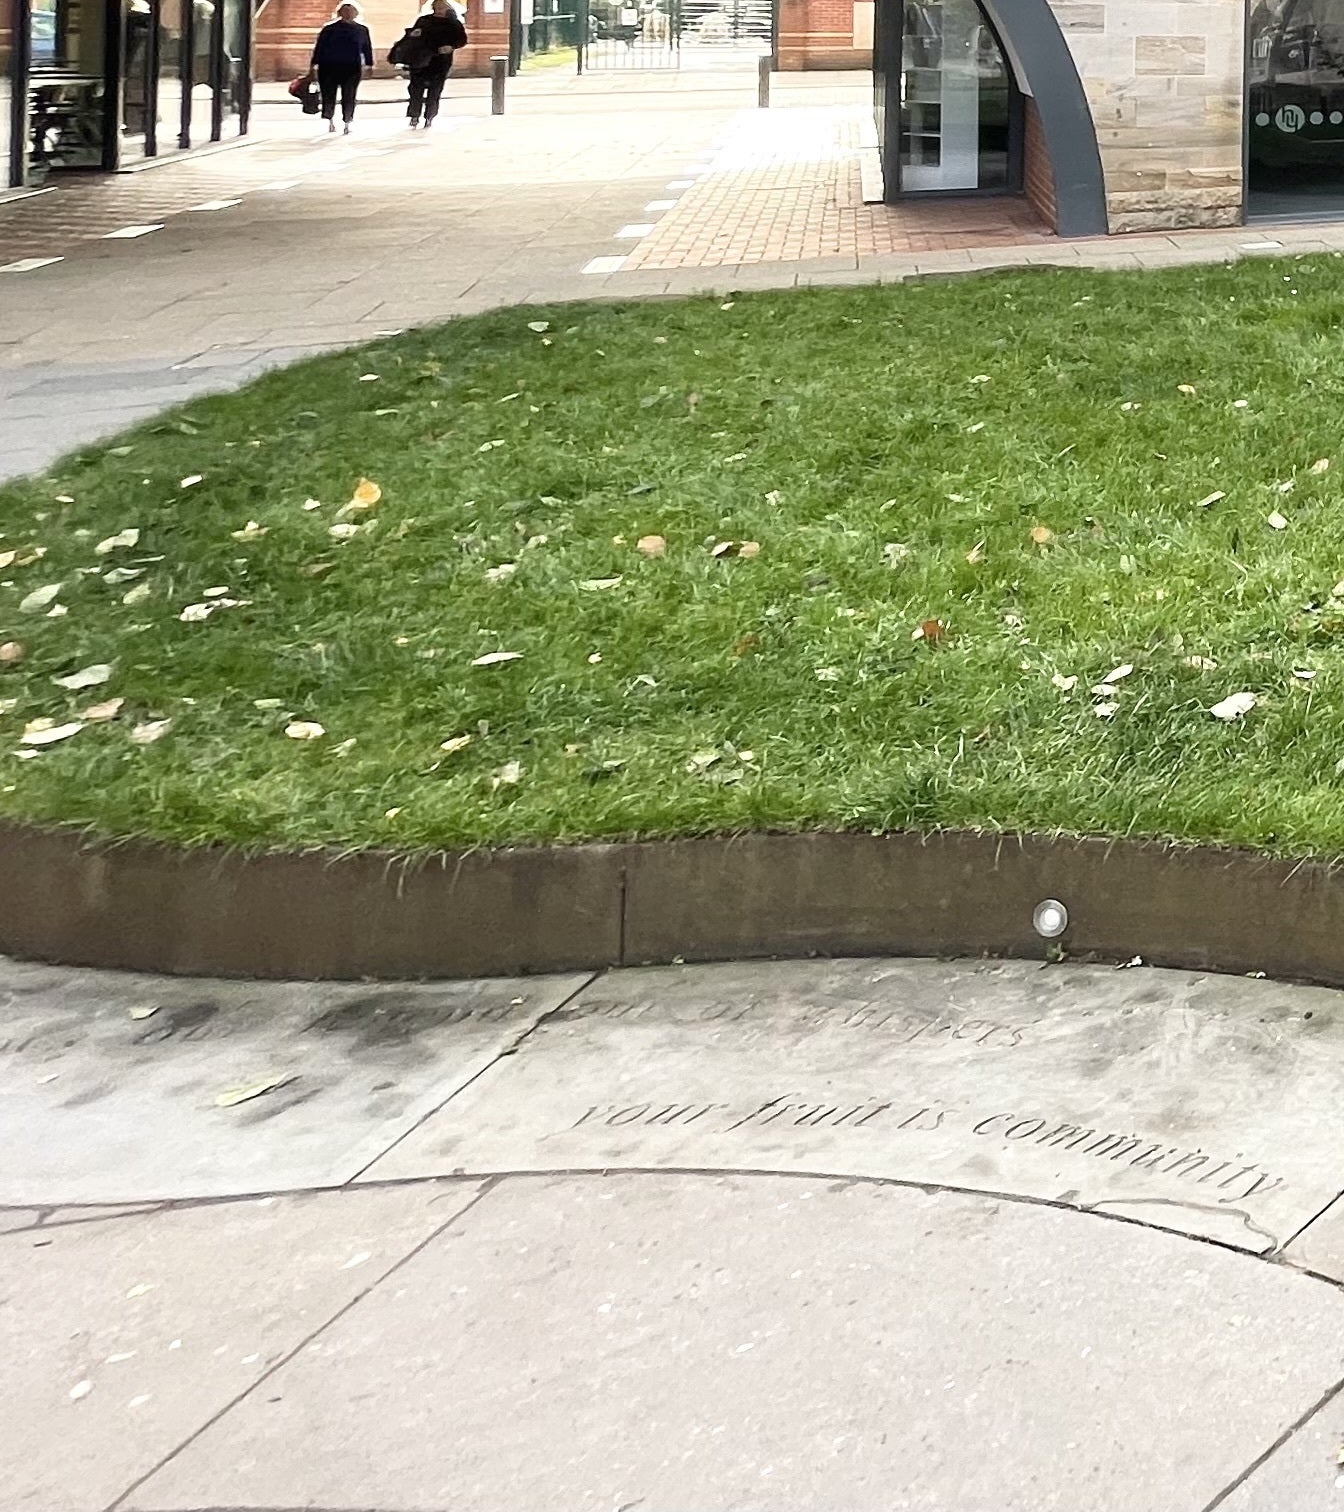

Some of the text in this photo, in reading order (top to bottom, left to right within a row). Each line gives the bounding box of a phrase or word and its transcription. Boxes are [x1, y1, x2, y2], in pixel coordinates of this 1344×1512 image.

[726, 1092, 893, 1132] fruit
[897, 1098, 952, 1131] is
[972, 1112, 1288, 1204] community
